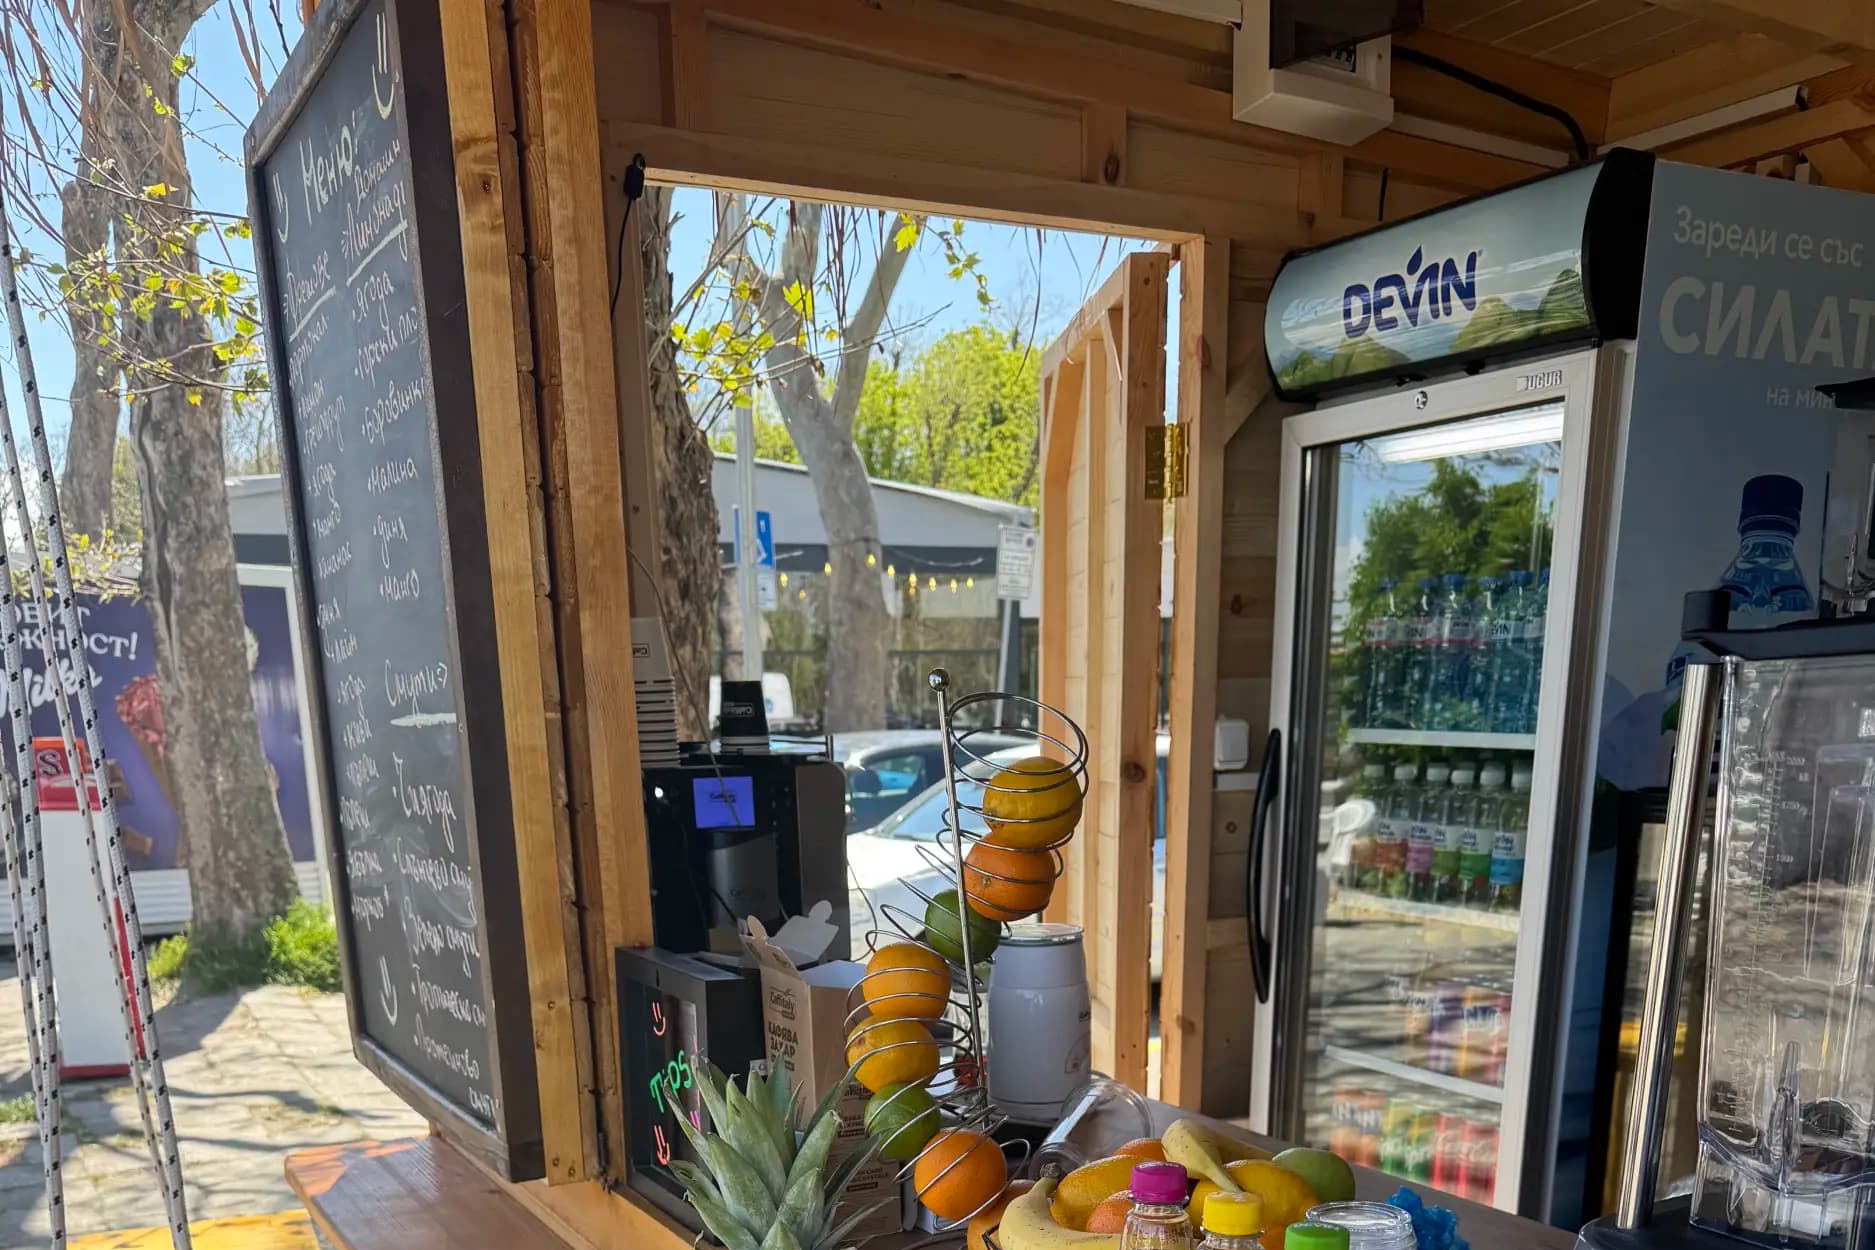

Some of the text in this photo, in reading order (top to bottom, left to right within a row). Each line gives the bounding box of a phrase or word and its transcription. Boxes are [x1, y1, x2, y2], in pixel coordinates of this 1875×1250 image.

[1673, 205, 1864, 267] Зареди се със
[357, 269, 394, 331] ягода
[1343, 251, 1477, 339] DEVIN
[1659, 276, 1875, 370] СИЛАТ
[1767, 387, 1790, 406] на
[377, 515, 408, 569] диня
[384, 567, 420, 600] манго
